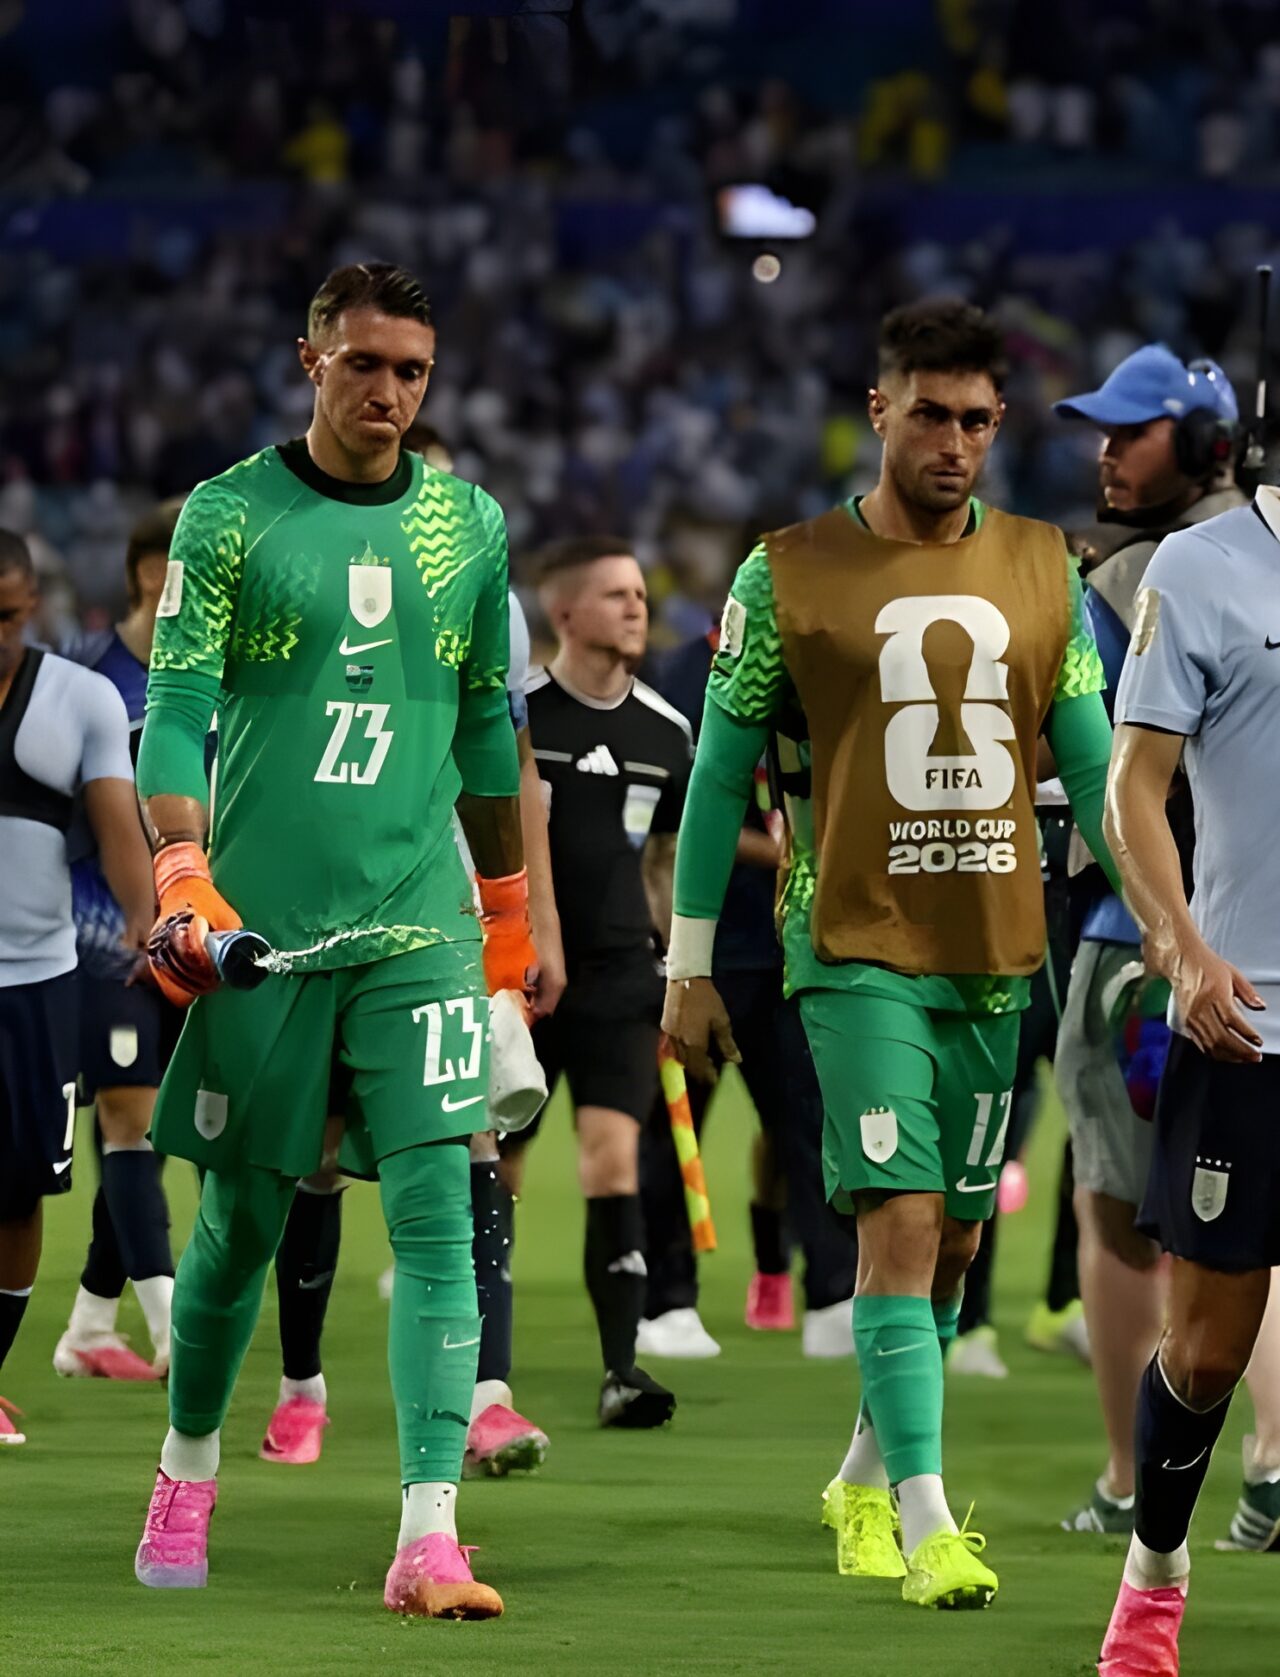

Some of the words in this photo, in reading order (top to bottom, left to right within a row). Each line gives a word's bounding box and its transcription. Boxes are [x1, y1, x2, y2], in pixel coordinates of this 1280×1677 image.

[313, 701, 394, 785] 23
[925, 768, 983, 789] FIFA
[889, 819, 971, 841] WORLD
[975, 818, 1017, 839] CUP
[888, 842, 1017, 875] 2026
[412, 997, 482, 1086] 23
